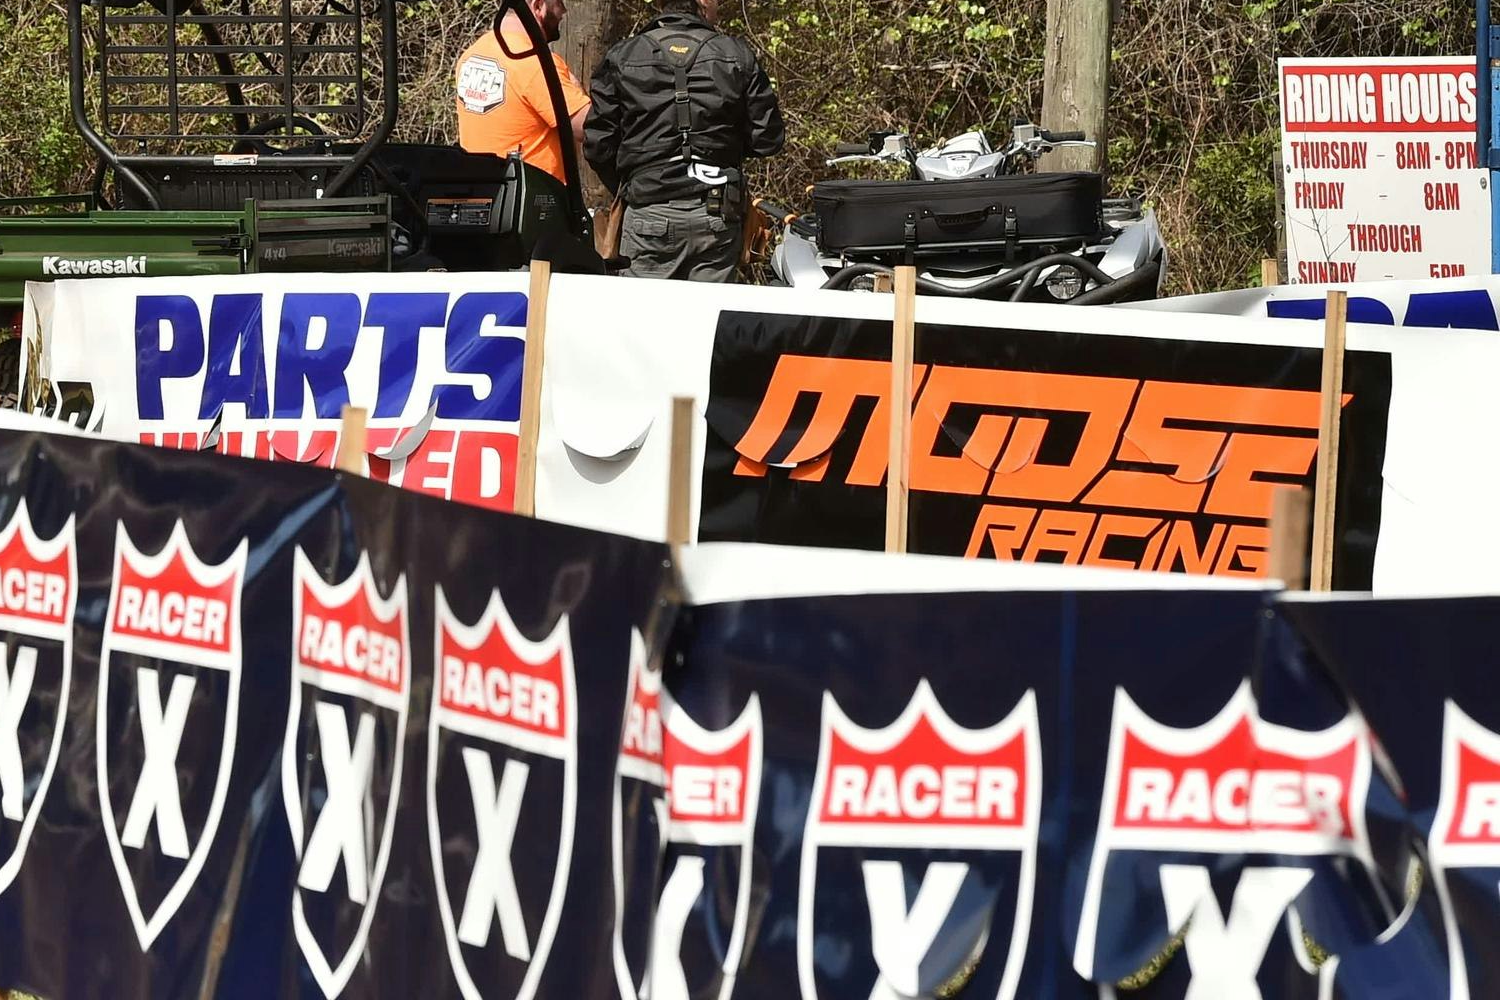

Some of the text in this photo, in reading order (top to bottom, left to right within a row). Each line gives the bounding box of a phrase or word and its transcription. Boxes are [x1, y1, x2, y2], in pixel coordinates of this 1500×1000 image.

[1285, 71, 1476, 124] RIDING HOURS
[1291, 141, 1367, 169] THURSDAY
[1395, 141, 1431, 169] 8AM
[1444, 141, 1478, 169] 8PM
[1294, 182, 1345, 210] FRIDAY
[1423, 182, 1460, 211] 8AM
[42, 255, 147, 275] Kawasaki
[264, 247, 288, 261] 4x4
[327, 237, 381, 257] Kawasaki
[1347, 223, 1422, 253] THROUGH
[1298, 261, 1356, 284] SUNDAY
[135, 291, 529, 422] PARTS
[963, 503, 1271, 579] RACING
[117, 586, 228, 645] RACER
[300, 614, 401, 686] RACER
[443, 655, 560, 731] RACER
[122, 667, 197, 860] X
[297, 701, 376, 906] X
[828, 765, 1018, 819] RACER
[1125, 766, 1345, 838] RACER
[458, 746, 530, 963] X
